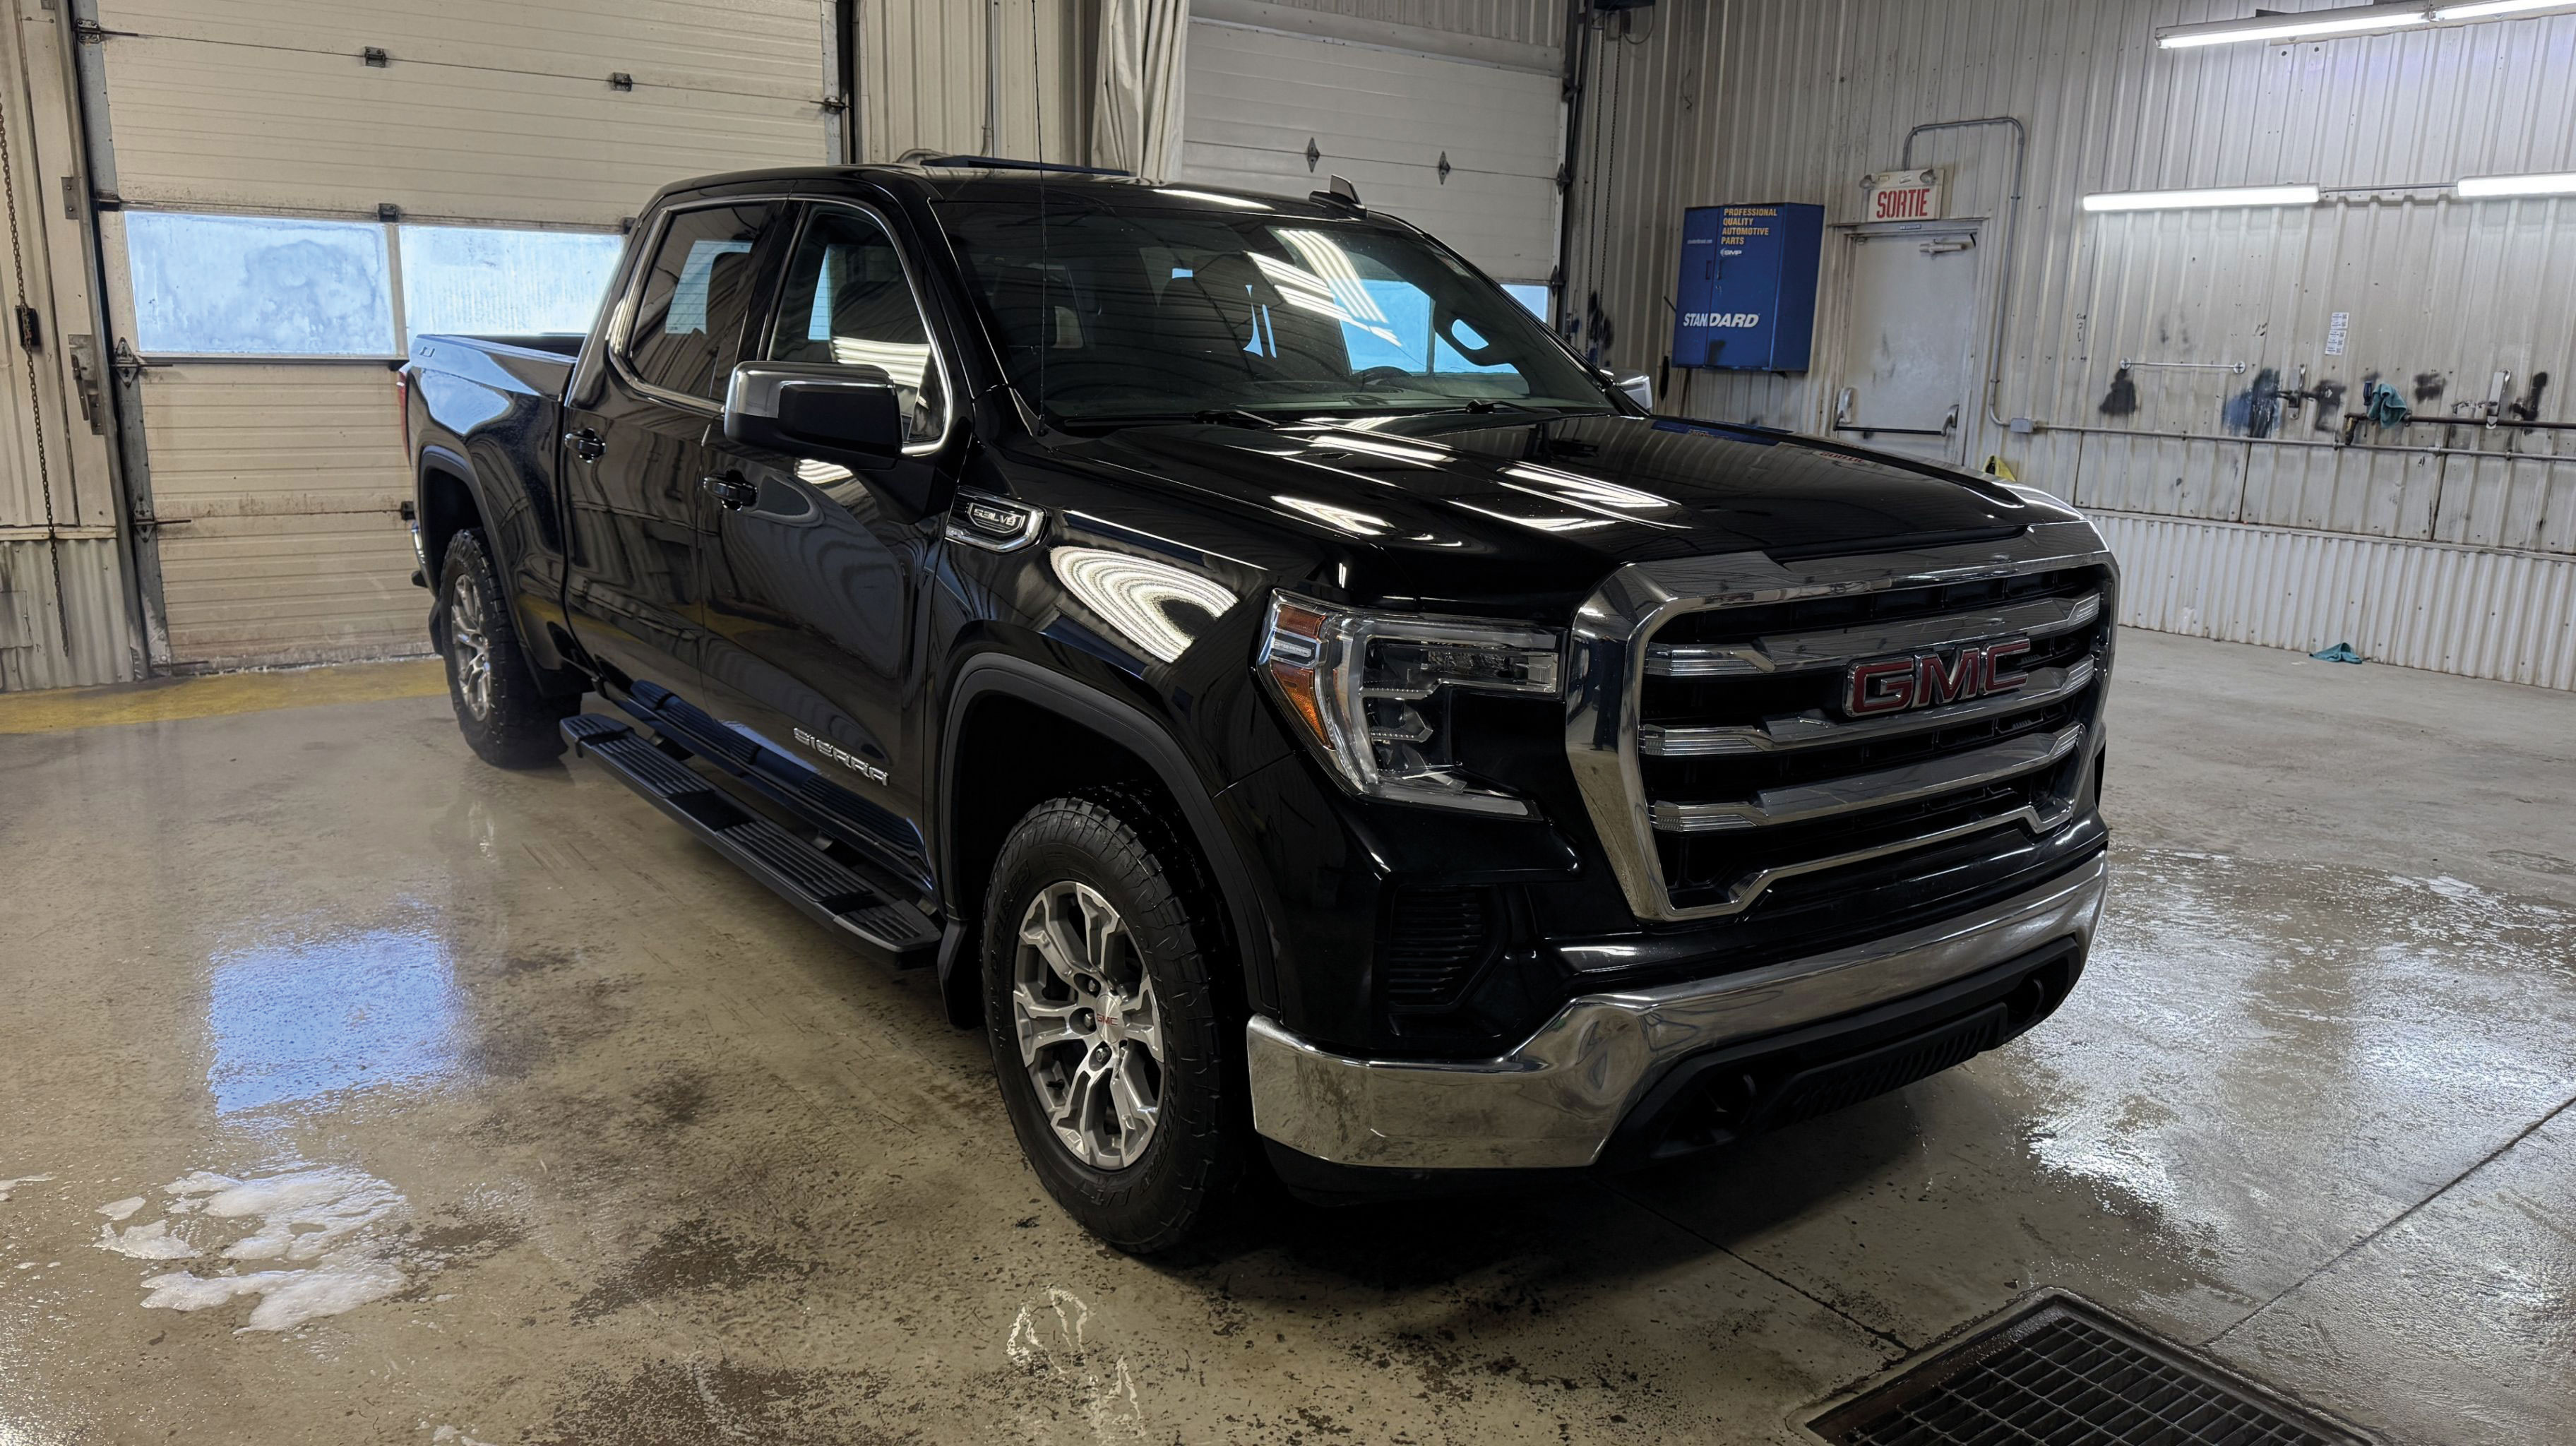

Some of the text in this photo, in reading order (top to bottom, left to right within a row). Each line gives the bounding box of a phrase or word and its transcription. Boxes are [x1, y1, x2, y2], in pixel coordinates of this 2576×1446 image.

[1876, 188, 1930, 219] SORTIE
[1723, 217, 1753, 226] QUALITY
[1721, 237, 1744, 245] PARTS
[1683, 313, 1759, 328] STANDARD
[1842, 638, 2030, 717] GMC
[794, 727, 888, 786] SIERRA
[1097, 1013, 1119, 1026] GMC
